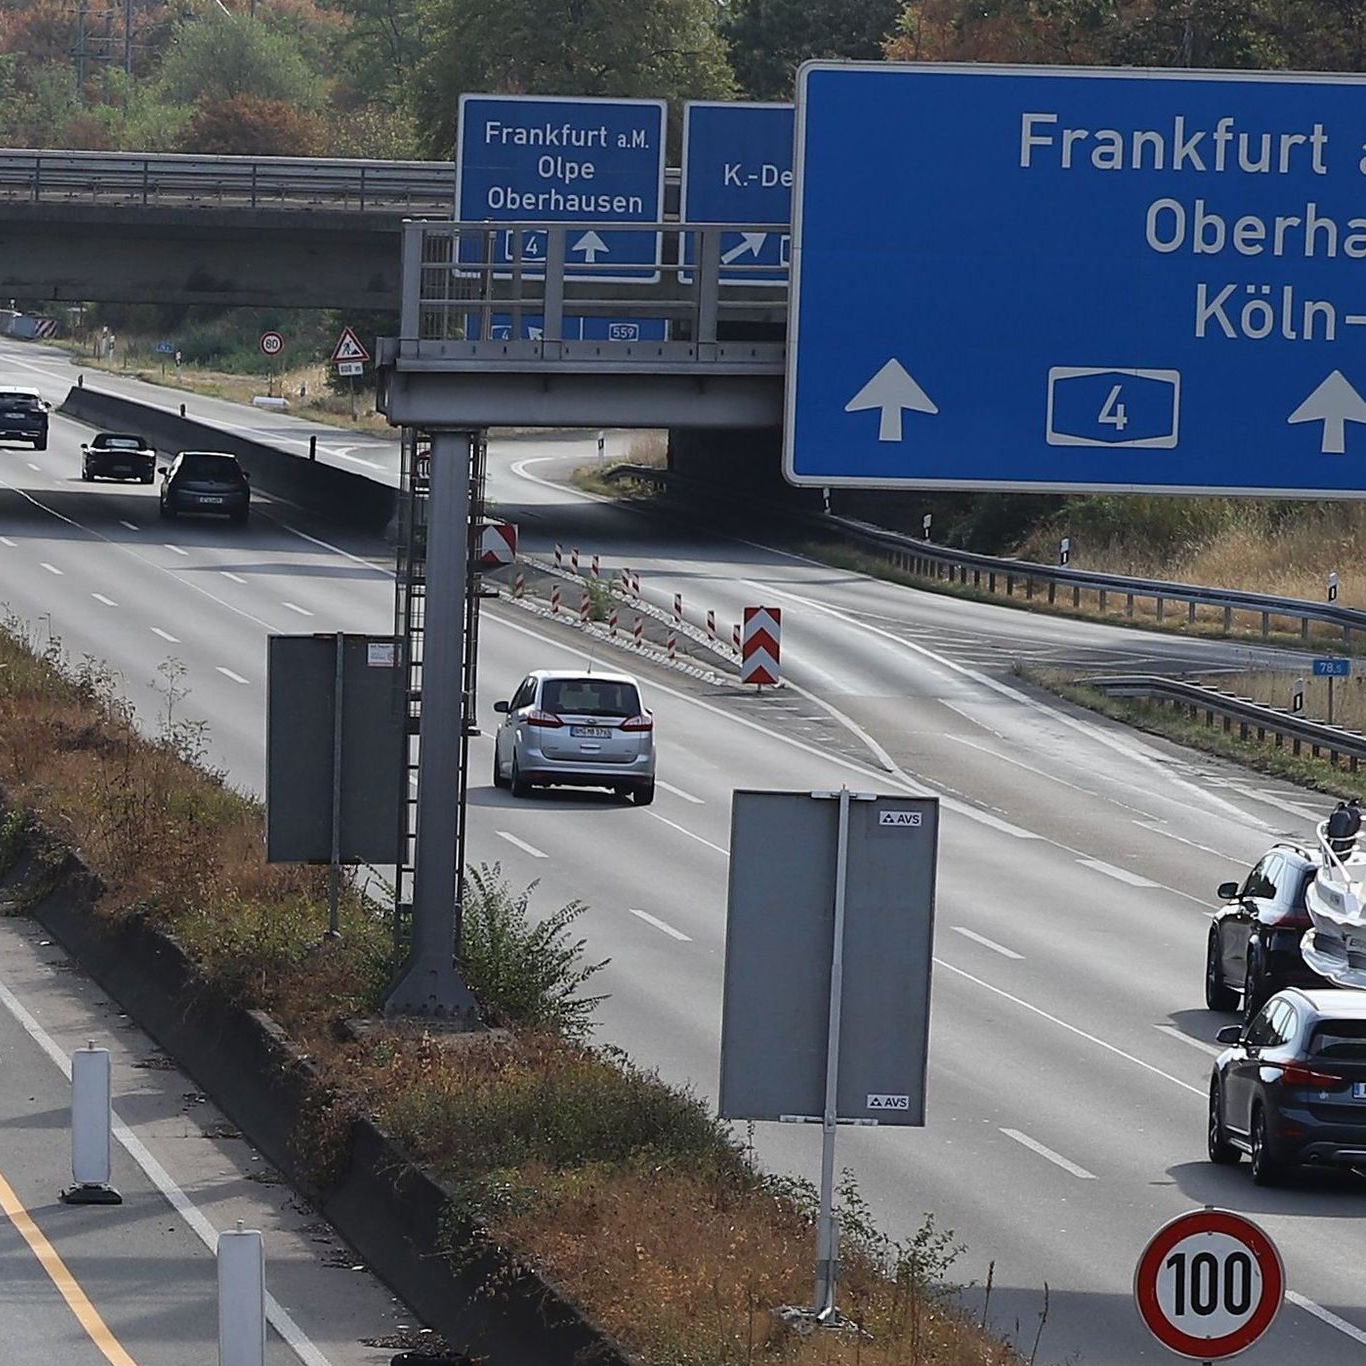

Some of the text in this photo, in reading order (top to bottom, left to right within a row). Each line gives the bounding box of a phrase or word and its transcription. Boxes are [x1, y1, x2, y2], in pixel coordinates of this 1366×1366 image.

[485, 122, 649, 148] Frankfurt a.M.
[1020, 113, 1329, 175] Frankfurt
[538, 156, 596, 184] Olpe
[488, 187, 643, 214] Oberhausen
[525, 236, 539, 255] 4
[613, 327, 635, 339] 559
[1096, 384, 1129, 431] 4
[897, 814, 920, 824] AVS
[884, 1097, 907, 1107] AVS
[1167, 1250, 1253, 1317] 100
